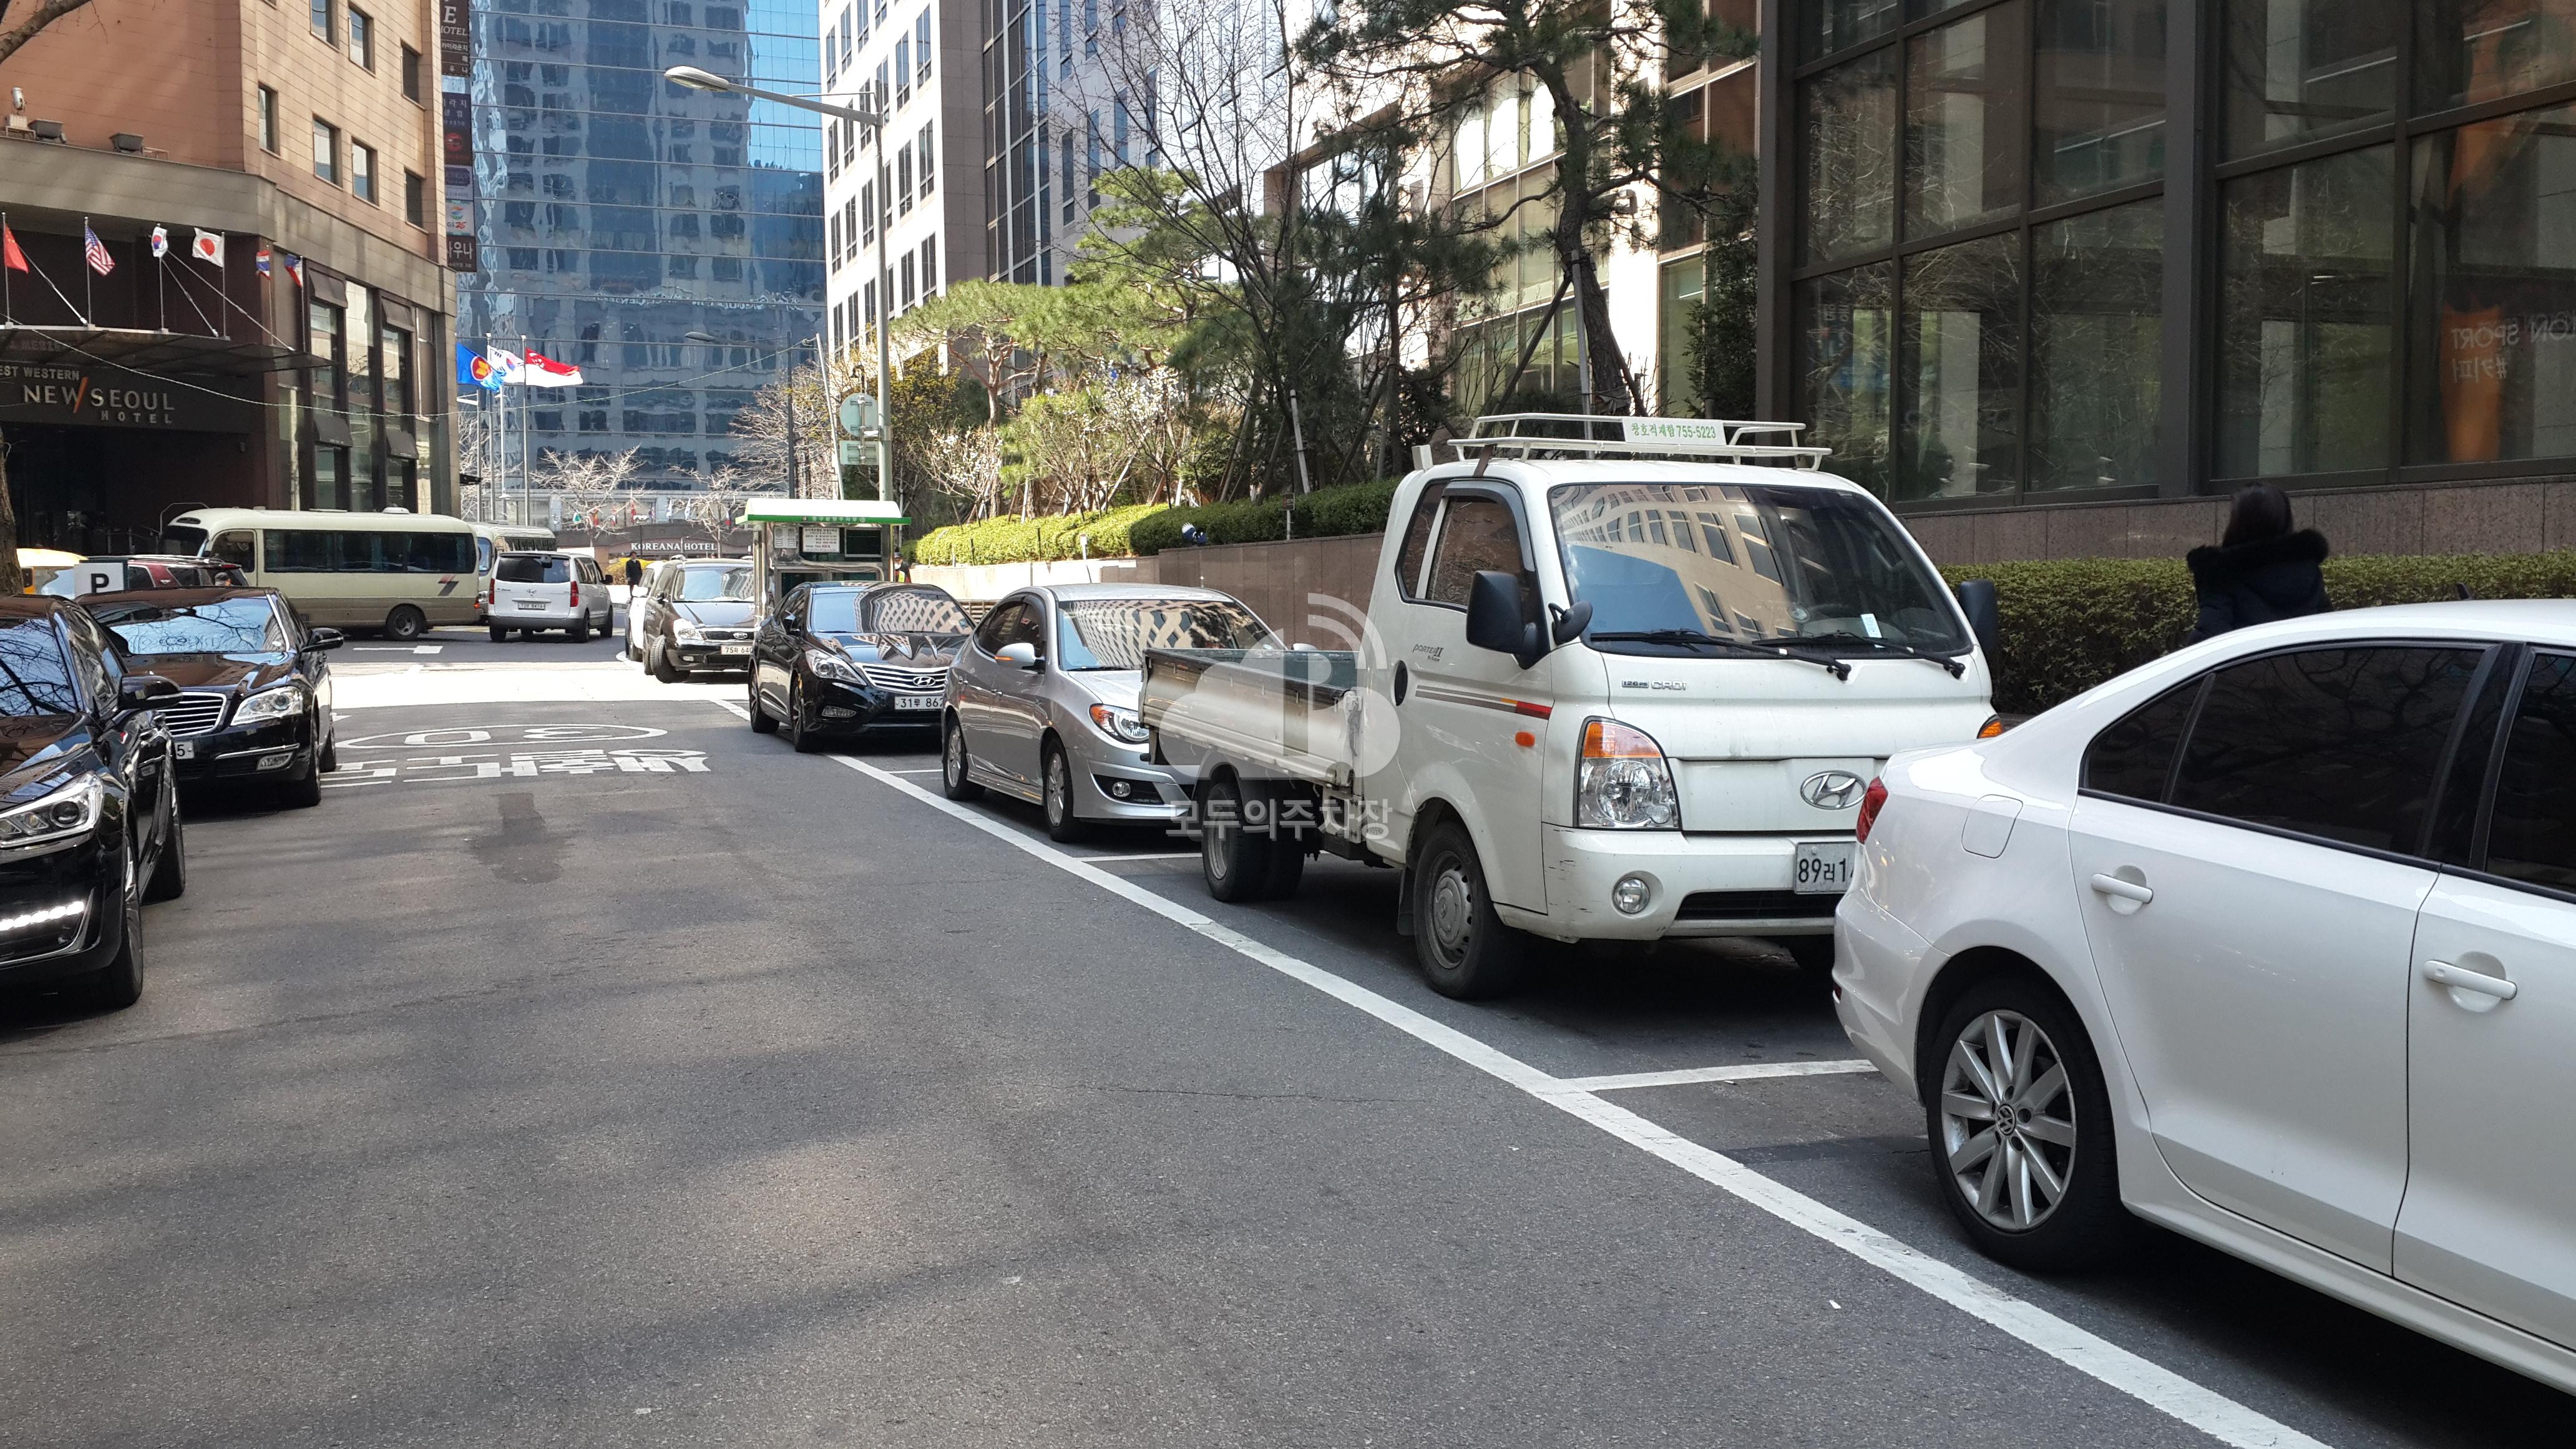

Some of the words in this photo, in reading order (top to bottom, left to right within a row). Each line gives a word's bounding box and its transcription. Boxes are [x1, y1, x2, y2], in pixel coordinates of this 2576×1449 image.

[23, 367, 80, 381] WESTERN
[23, 384, 81, 405] NEW
[90, 388, 175, 411] SEOUL
[101, 410, 172, 424] HOTEL
[1676, 425, 1716, 439] 755-5223
[630, 542, 681, 550] KOREANA
[90, 573, 109, 593] P
[320, 749, 711, 789] 생활도로
